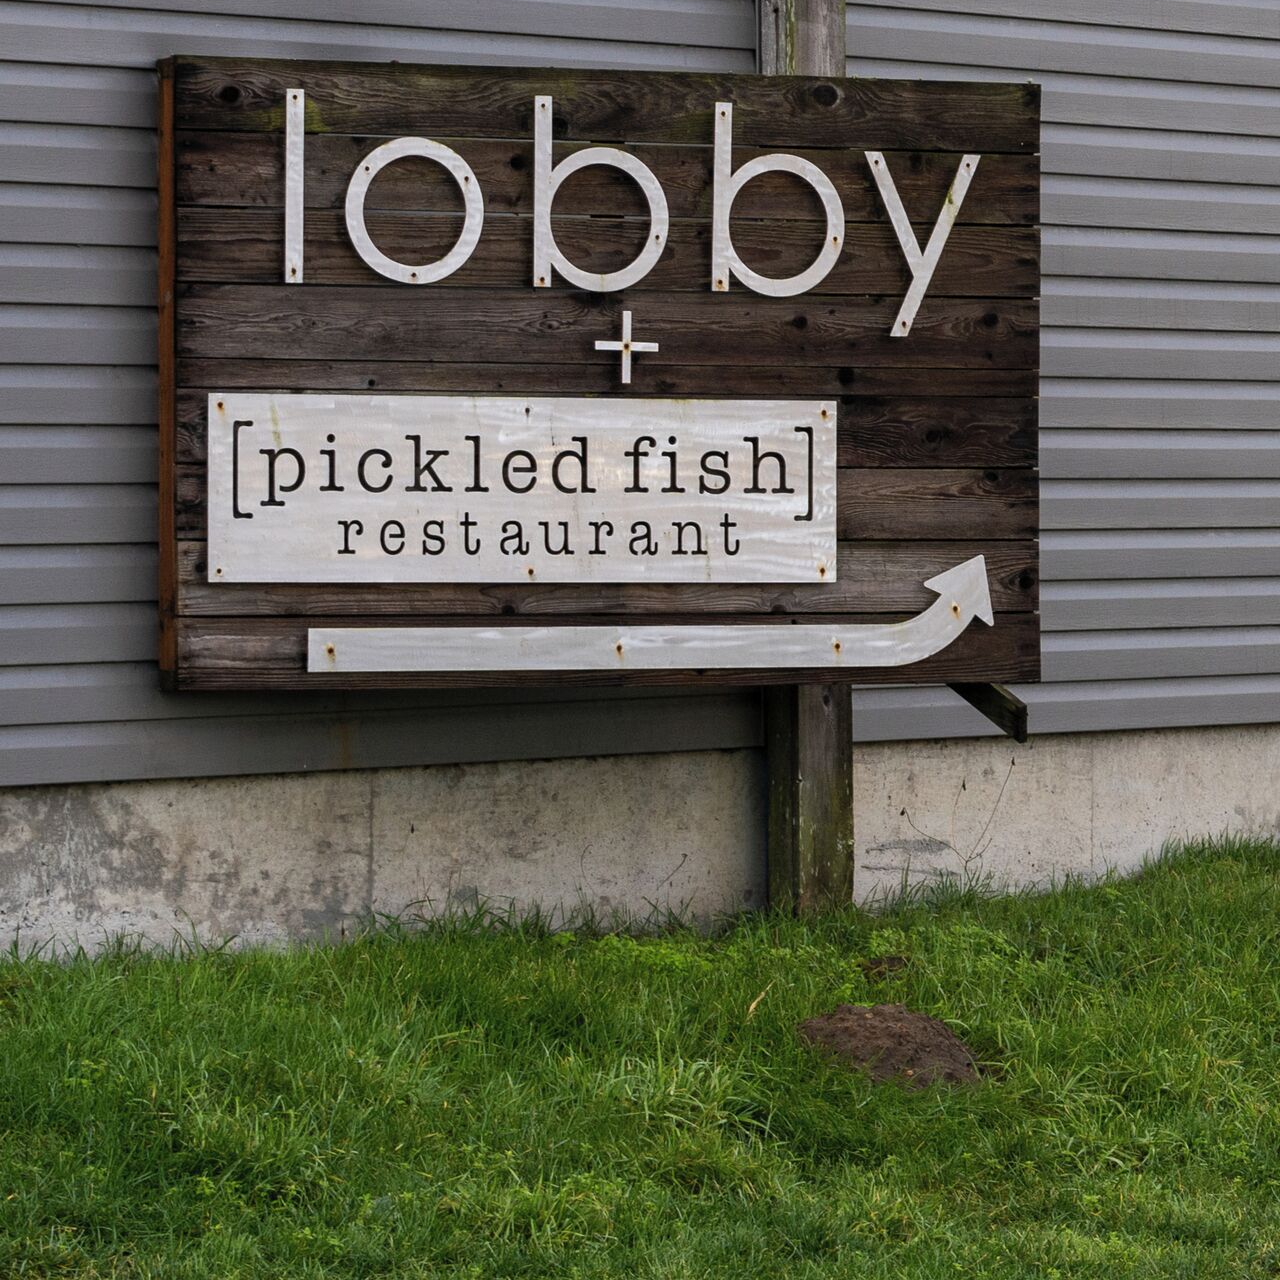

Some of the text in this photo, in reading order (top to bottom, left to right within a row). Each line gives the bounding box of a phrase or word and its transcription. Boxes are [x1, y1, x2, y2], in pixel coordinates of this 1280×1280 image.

[285, 88, 981, 337] lobby
[594, 310, 659, 384] +
[337, 510, 742, 556] restaurant
